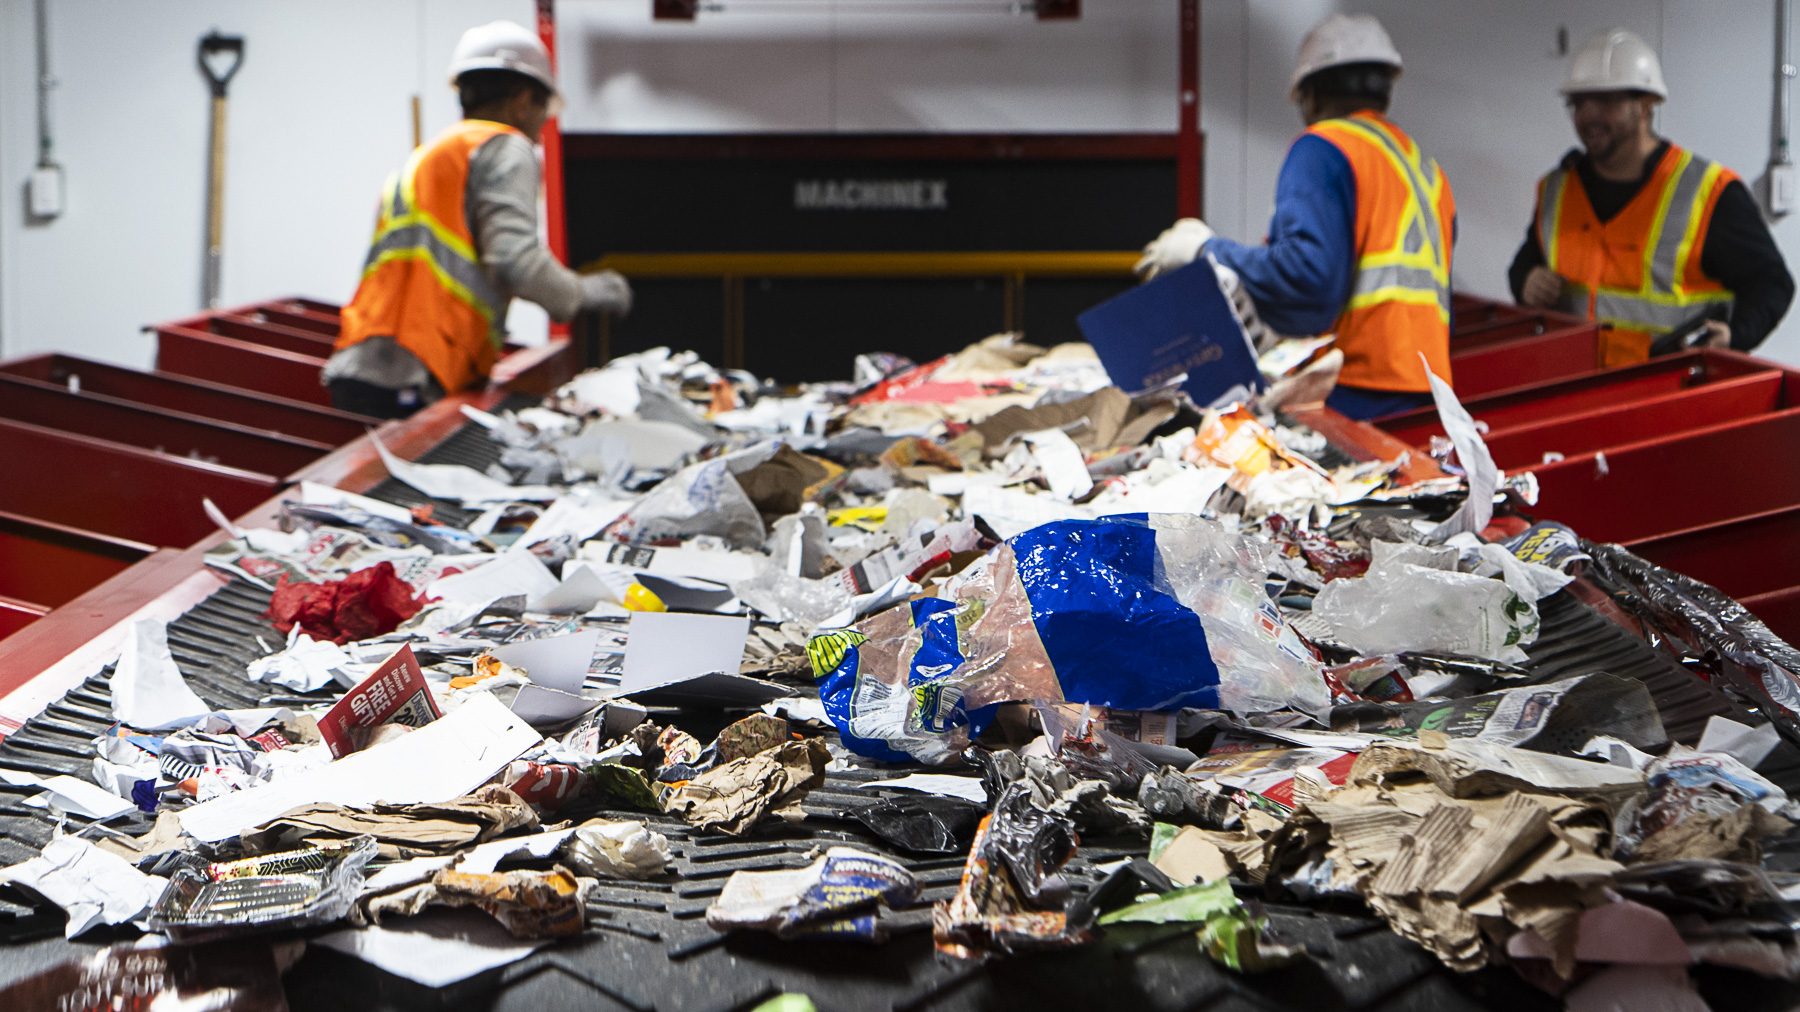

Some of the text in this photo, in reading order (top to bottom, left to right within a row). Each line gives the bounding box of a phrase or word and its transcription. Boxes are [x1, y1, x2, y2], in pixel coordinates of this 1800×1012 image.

[795, 180, 947, 208] MACHINEX
[350, 693, 377, 728] GIFT!
[366, 679, 392, 716] FREE
